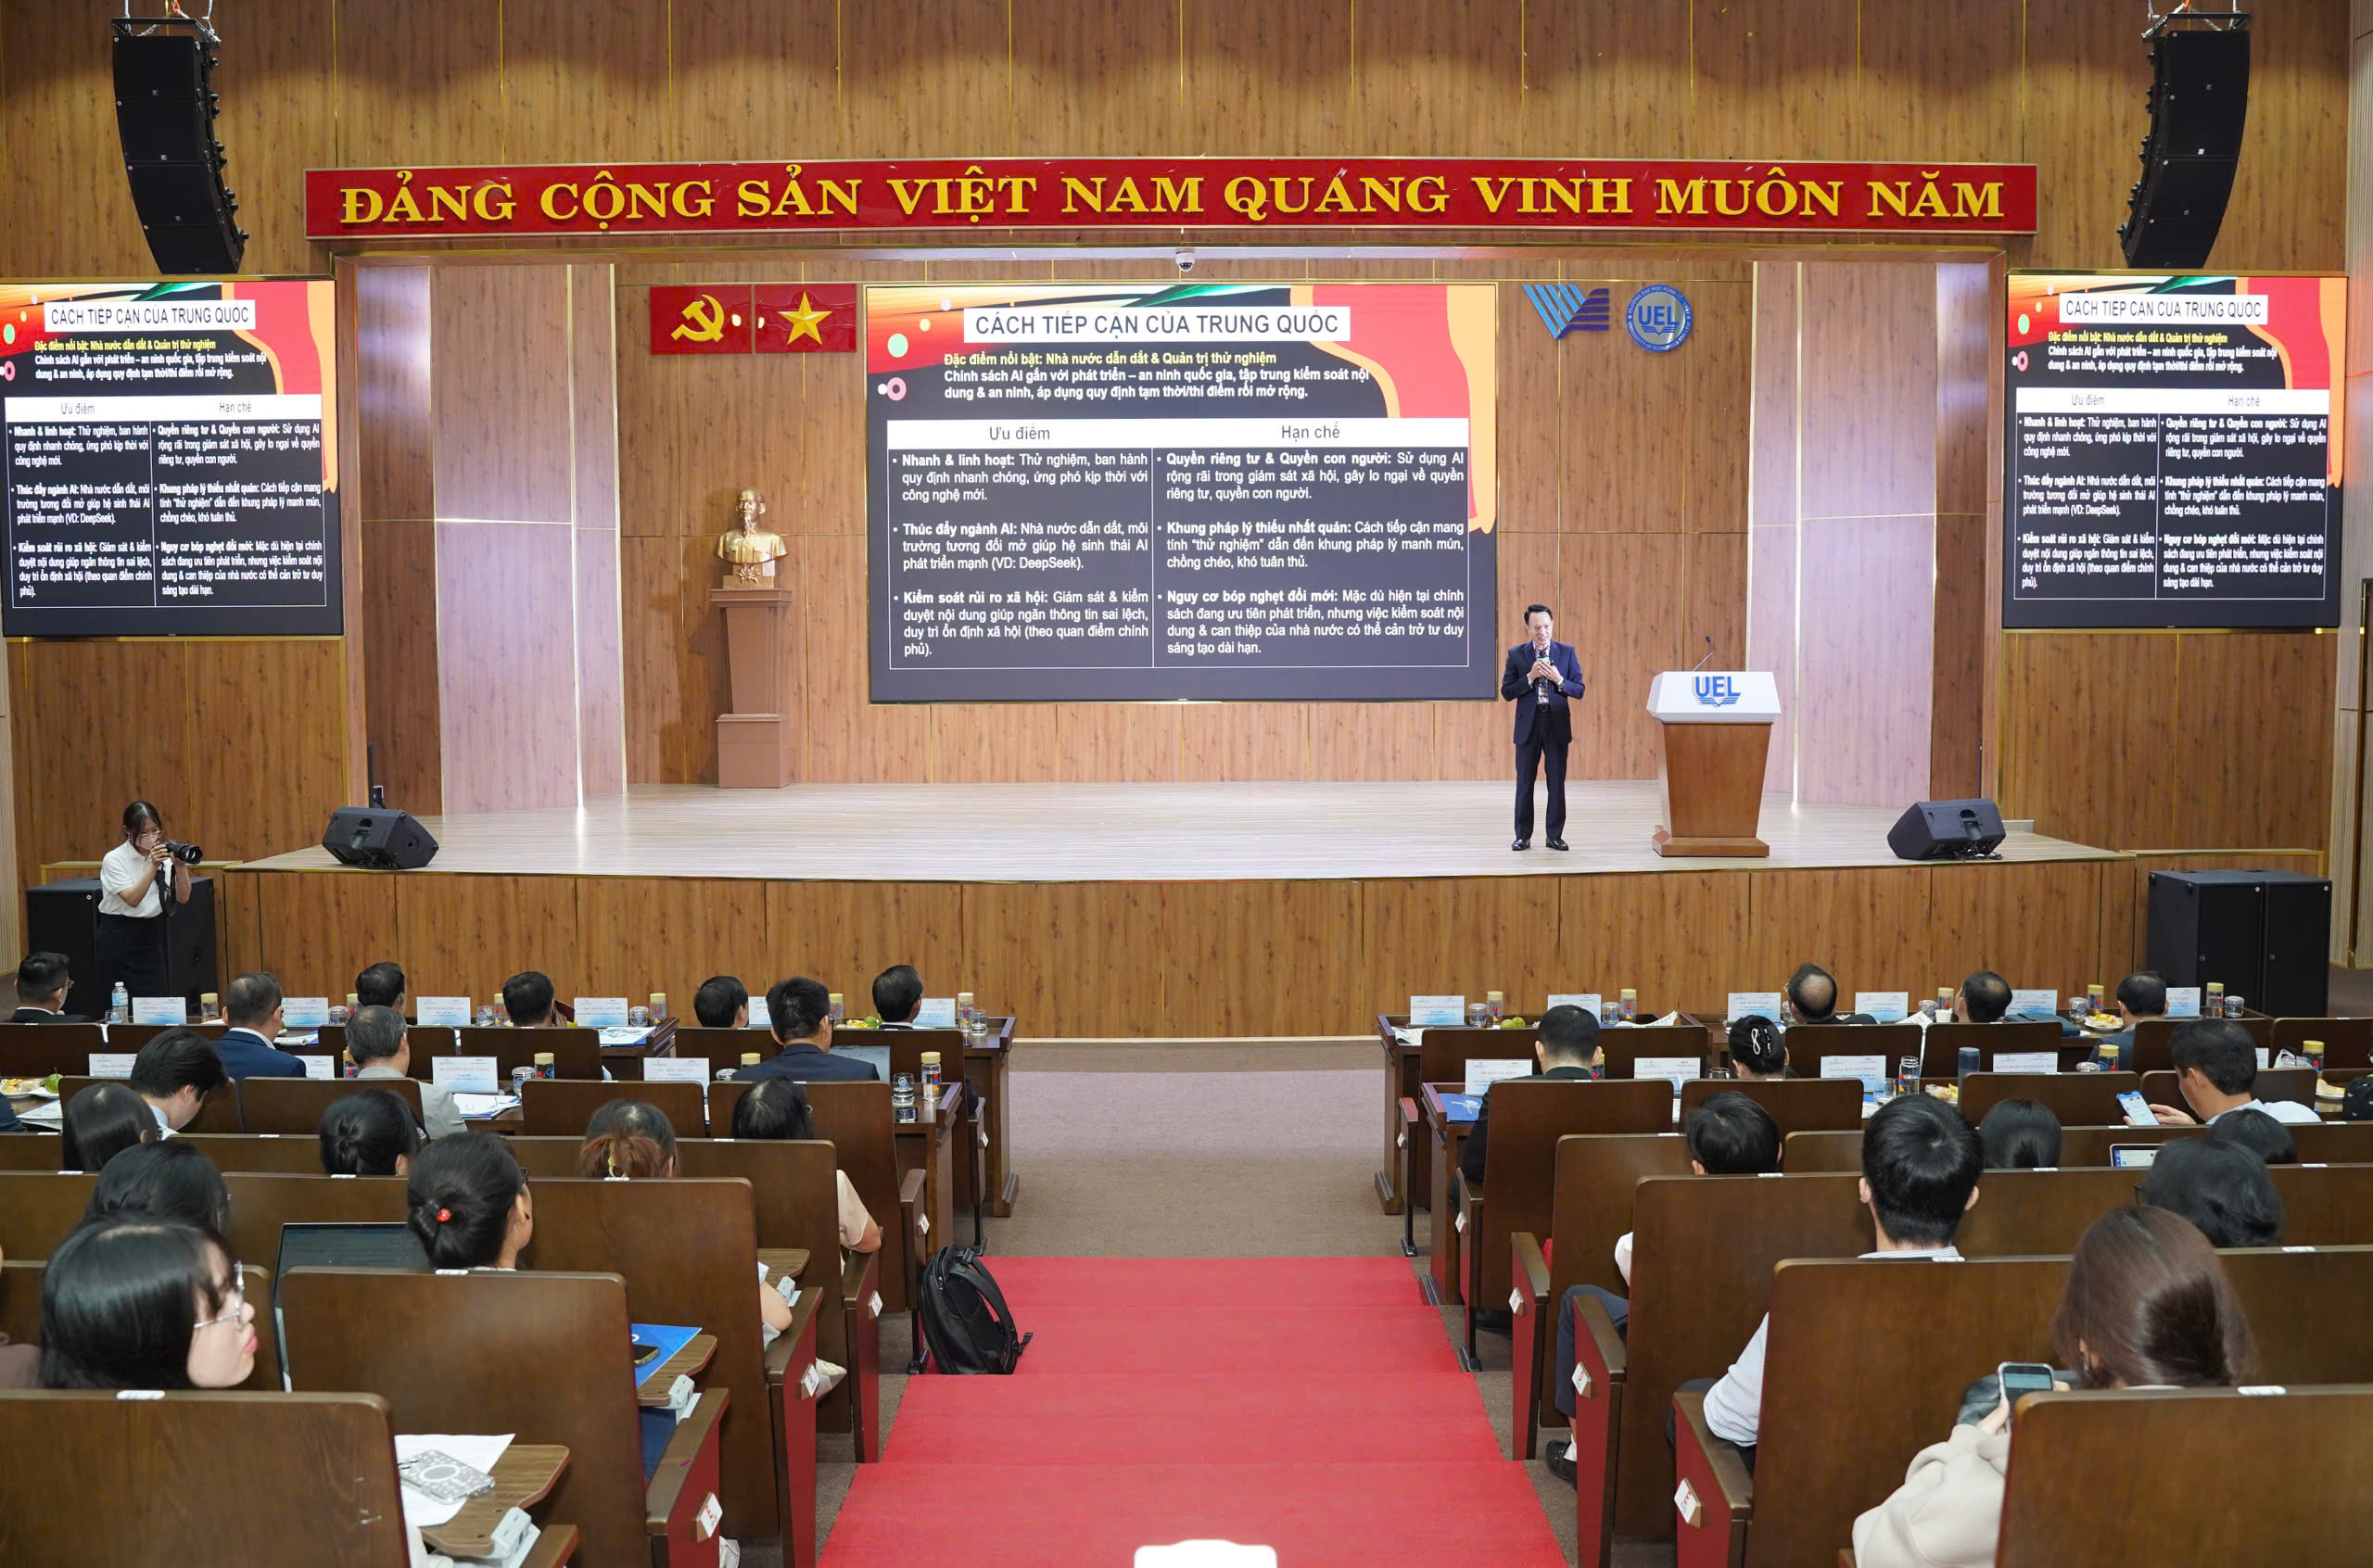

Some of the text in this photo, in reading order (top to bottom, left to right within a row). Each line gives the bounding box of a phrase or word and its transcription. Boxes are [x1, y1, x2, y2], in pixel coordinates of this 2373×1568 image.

[340, 164, 2004, 229] ĐẢNG CỘNG SẢN VIỆT NAM QUANG VINH MUÔN NĂM
[51, 307, 83, 324] CÁCH
[171, 307, 210, 323] TRUNG
[1639, 306, 1680, 326] UEL
[2065, 297, 2098, 315] CÁCH
[2185, 300, 2224, 317] TRUNG
[975, 310, 1338, 339] CÁCH TIẾP CẬN CỦA TRUNG QUỐC
[944, 349, 1276, 368] Đặc điểm nổi bật: Nhà nước dẫn dắt & Quản trị thử nghiệm
[944, 369, 978, 382] Chính
[981, 369, 1008, 382] sách
[1010, 369, 1022, 381] AI
[1025, 365, 1047, 384] gắn
[1049, 369, 1068, 381] với
[1072, 369, 1098, 384] phát
[1099, 366, 1125, 381] triển
[1138, 371, 1152, 380] an
[1155, 369, 1181, 380] ninh
[1184, 364, 1212, 383] quốc
[1215, 368, 1236, 385] gia,
[1238, 367, 1257, 384] tập
[1259, 369, 1290, 383] trung
[1293, 365, 1320, 380] kiểm
[1323, 368, 1349, 380] soát
[1351, 367, 1369, 383] nội
[944, 386, 973, 400] dung
[976, 386, 985, 398] &
[987, 388, 1002, 398] an
[1005, 386, 1034, 399] ninh,
[1036, 386, 1051, 400] áp
[1053, 386, 1083, 400] dụng
[1085, 387, 1108, 400] quy
[1110, 385, 1136, 400] định
[1137, 386, 1160, 400] tạm
[1206, 381, 1235, 397] điểm
[1237, 381, 1253, 397] rồi
[1255, 384, 1275, 397] mở
[1277, 384, 1308, 399] rộng.
[989, 424, 1049, 440] Ưu điểm
[1281, 421, 1339, 442] Hạn chế
[902, 452, 1148, 468] Nhanh & linh hoạt: Thử nghiệm, ban hành
[1166, 449, 1464, 467] Quyền riêng tư & Quyền con người: Sử dụng AI
[902, 470, 1148, 486] quy định nhanh chóng, ứng phó kịp thời với
[1166, 466, 1464, 485] rộng rãi trong giám sát xã hội, gây lo ngại về quyền
[902, 487, 987, 503] công nghệ mới.
[1166, 485, 1312, 501] riêng tư, quyền con người.
[902, 519, 1148, 537] Thúc đẩy ngành AI: Nhà nước dẫn dắt, môi
[902, 537, 1148, 554] trường tương đối mở giúp hệ sinh thái AI
[903, 553, 1084, 571] phát triển mạnh (VD: DeepSeek).
[1167, 641, 1261, 656] sáng tạo dài hạn.
[1695, 676, 1742, 697] UEL
